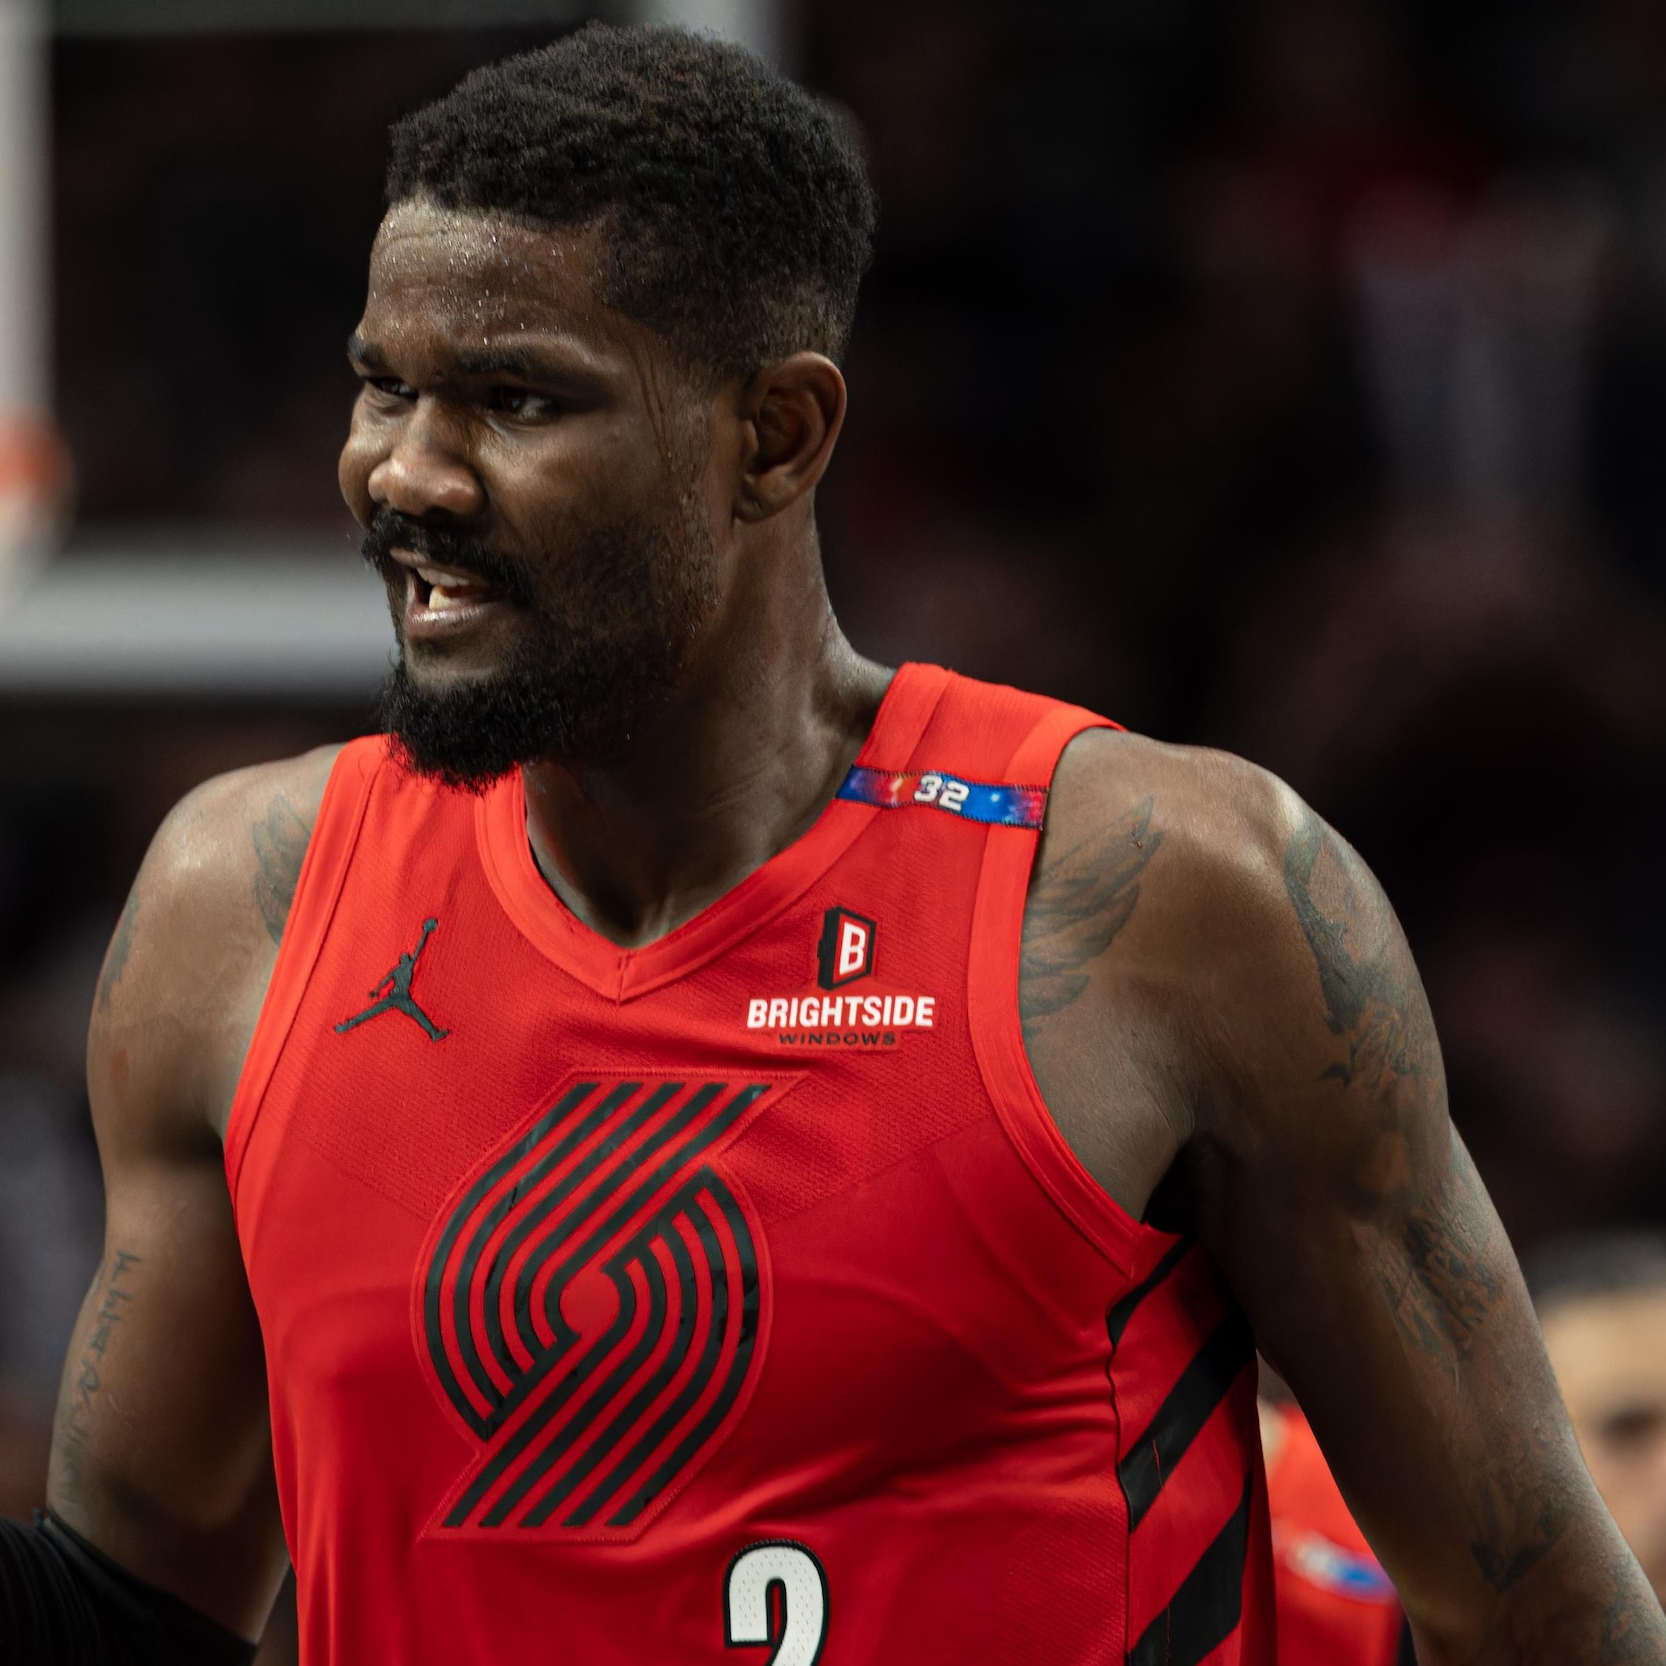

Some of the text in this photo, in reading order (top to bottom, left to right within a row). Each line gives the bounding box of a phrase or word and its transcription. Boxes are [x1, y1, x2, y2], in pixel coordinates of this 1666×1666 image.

[913, 774, 970, 812] 32
[838, 921, 867, 976] B
[746, 995, 936, 1029] BRIGHTSIDE
[778, 1031, 897, 1046] WINDOWS
